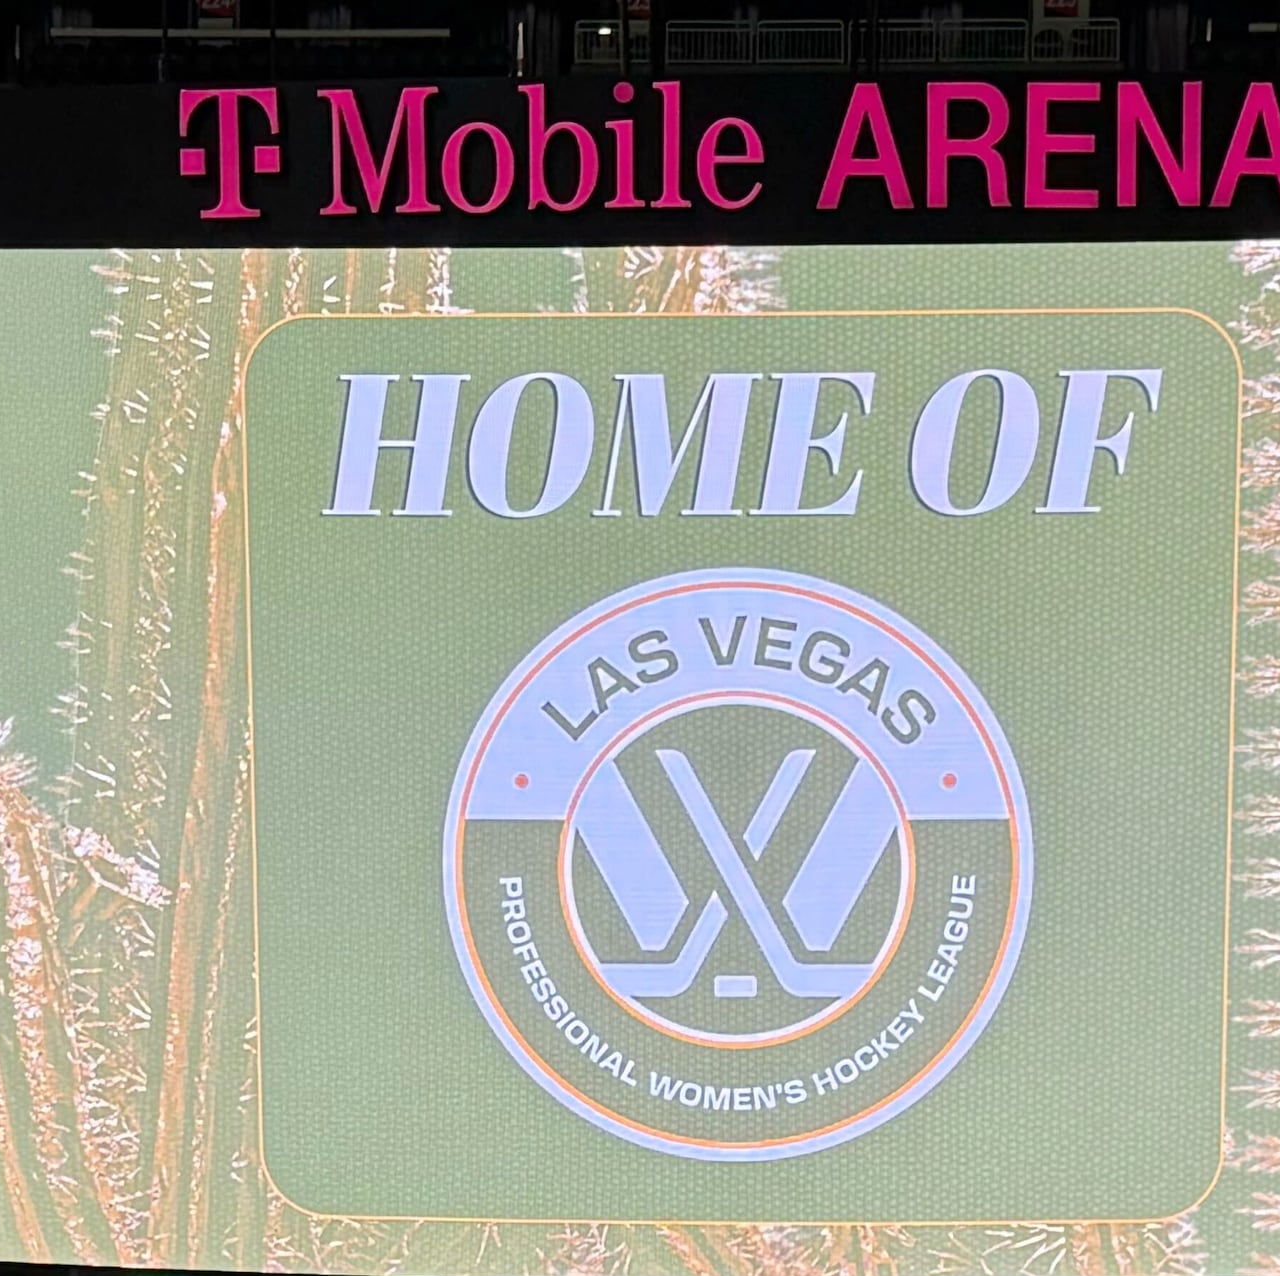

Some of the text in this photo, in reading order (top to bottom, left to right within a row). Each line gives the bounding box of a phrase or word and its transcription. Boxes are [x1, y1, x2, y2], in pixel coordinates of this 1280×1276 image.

[318, 80, 765, 215] Mobile
[320, 368, 1164, 518] HOME OF
[541, 614, 938, 746] LAS VEGAS
[498, 873, 978, 1112] PROFESSIONAL WOMEN'S HOCKEY LEAGUE
